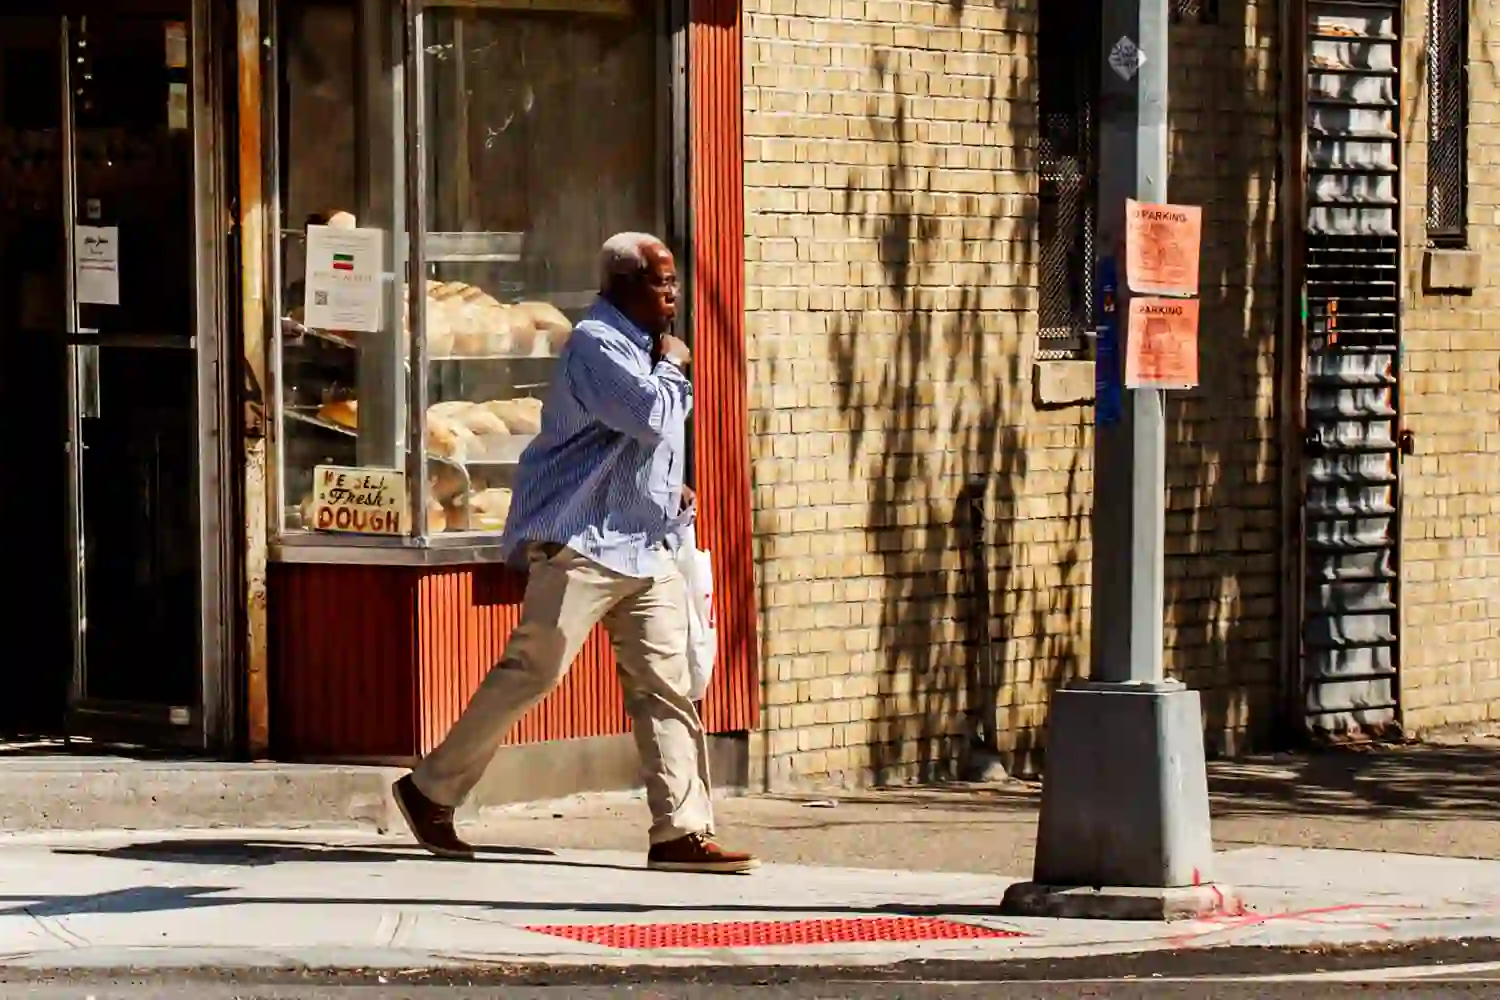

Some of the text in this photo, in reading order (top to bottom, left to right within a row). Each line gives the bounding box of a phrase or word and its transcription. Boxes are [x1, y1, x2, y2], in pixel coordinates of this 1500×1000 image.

[1141, 209, 1188, 223] PARKING
[327, 487, 384, 507] Fresh
[317, 505, 400, 533] DOUGH
